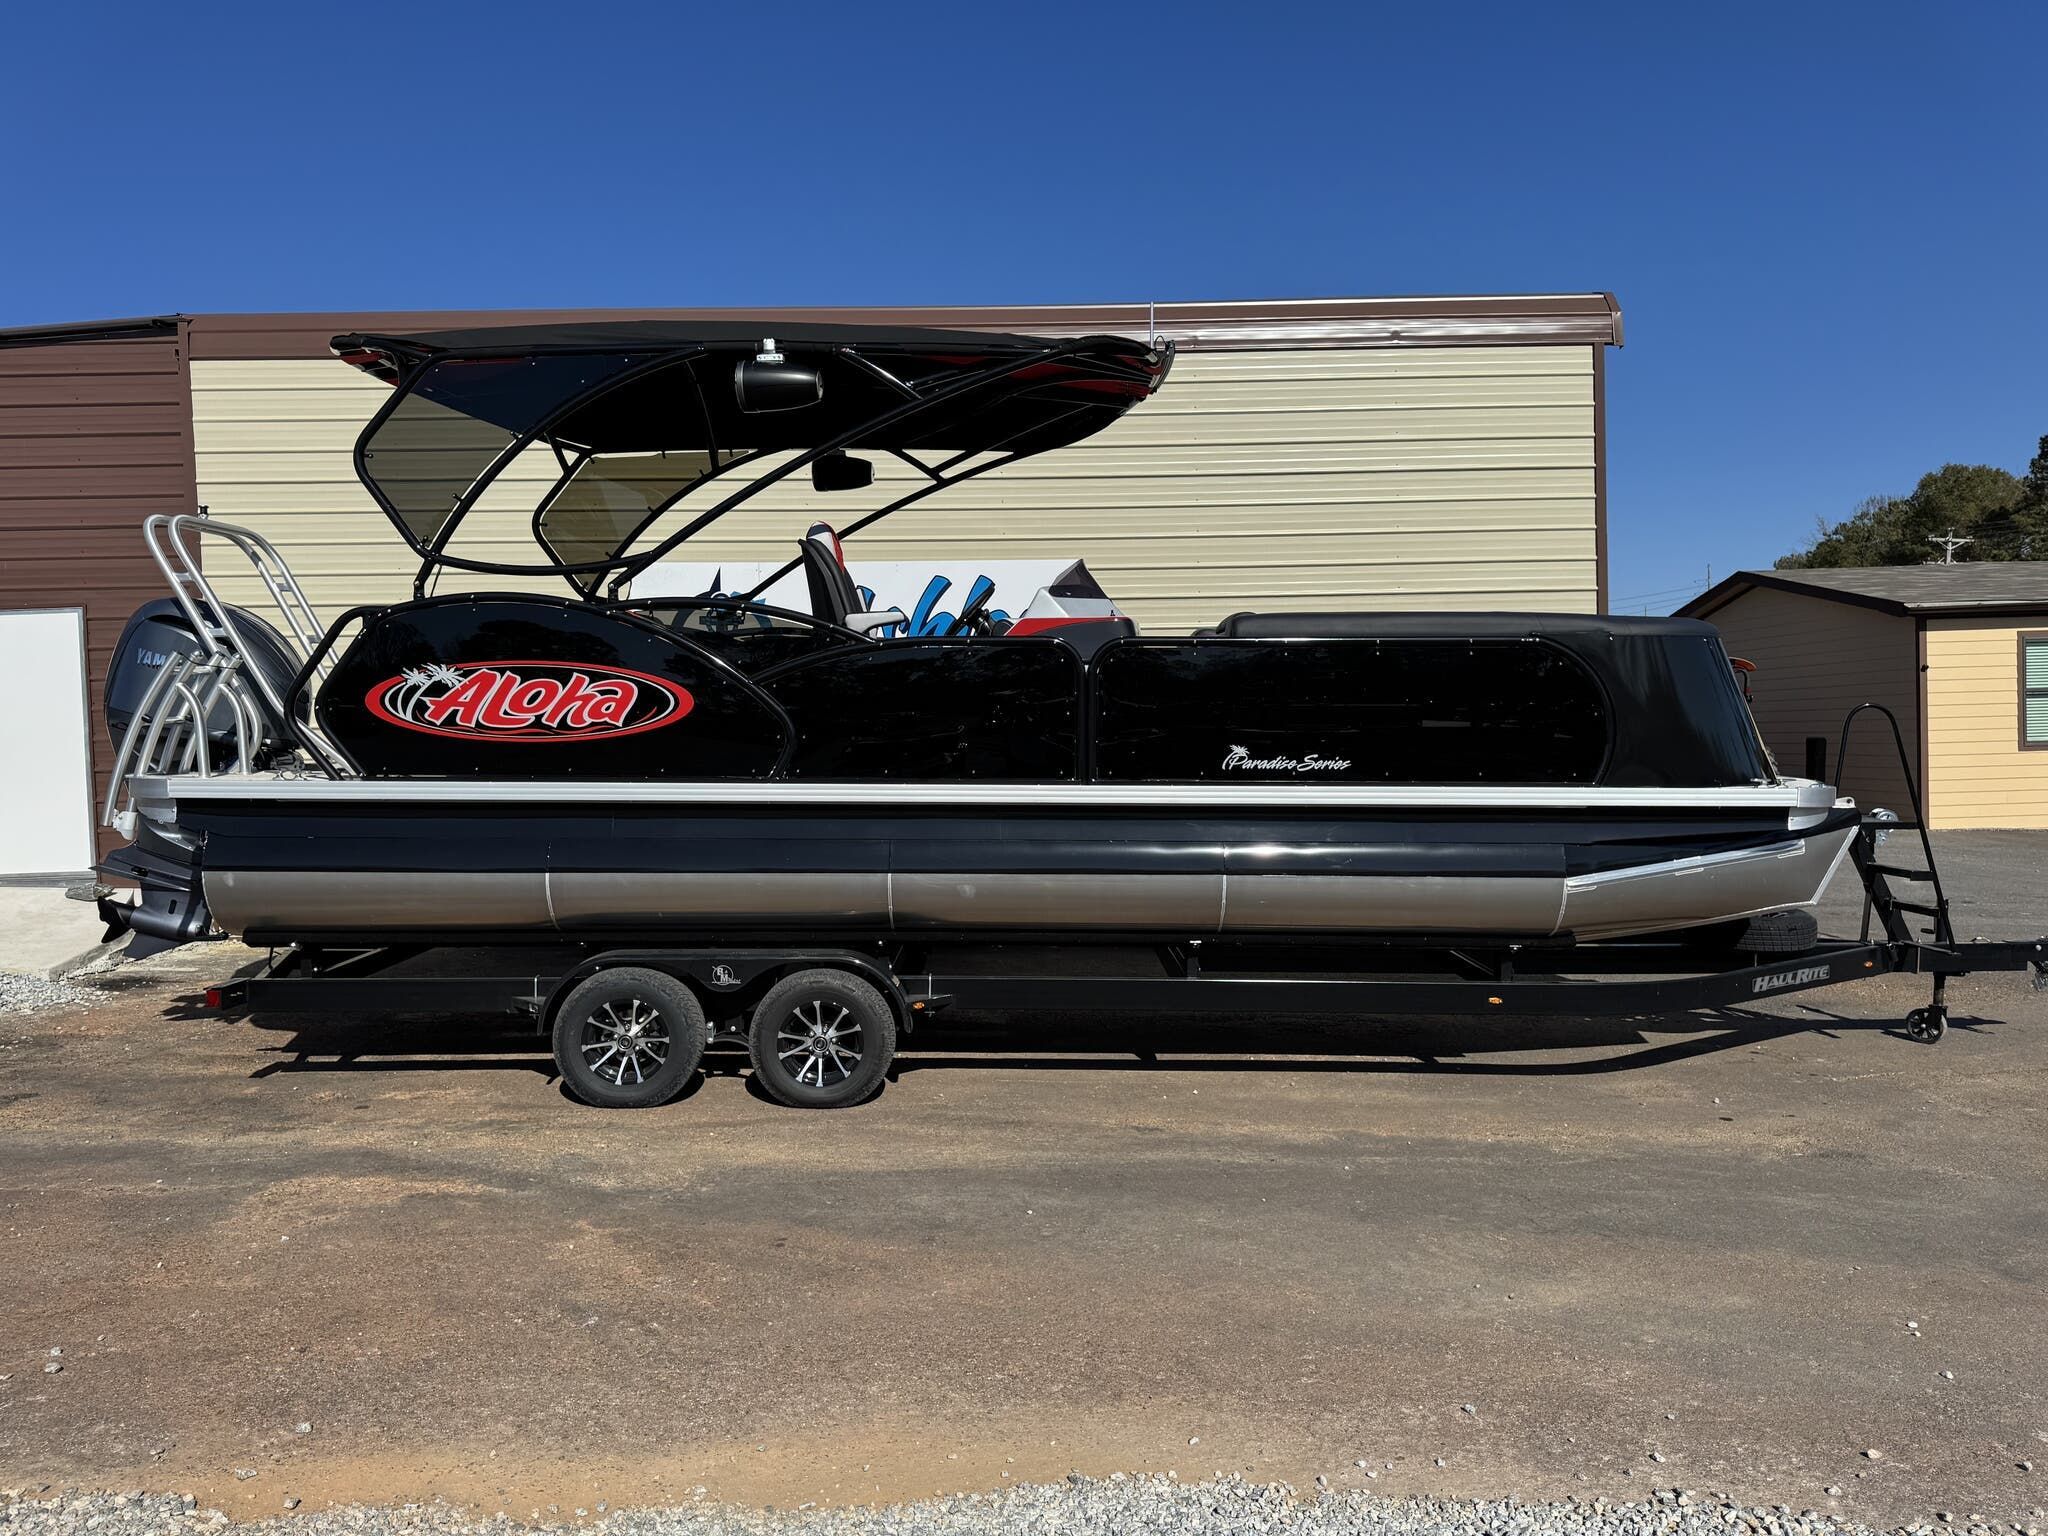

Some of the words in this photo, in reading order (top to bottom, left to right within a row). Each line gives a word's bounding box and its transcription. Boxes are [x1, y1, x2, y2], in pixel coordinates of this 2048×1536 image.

[137, 647, 167, 666] YAM
[1228, 754, 1297, 771] Paradise
[1297, 754, 1352, 771] Series
